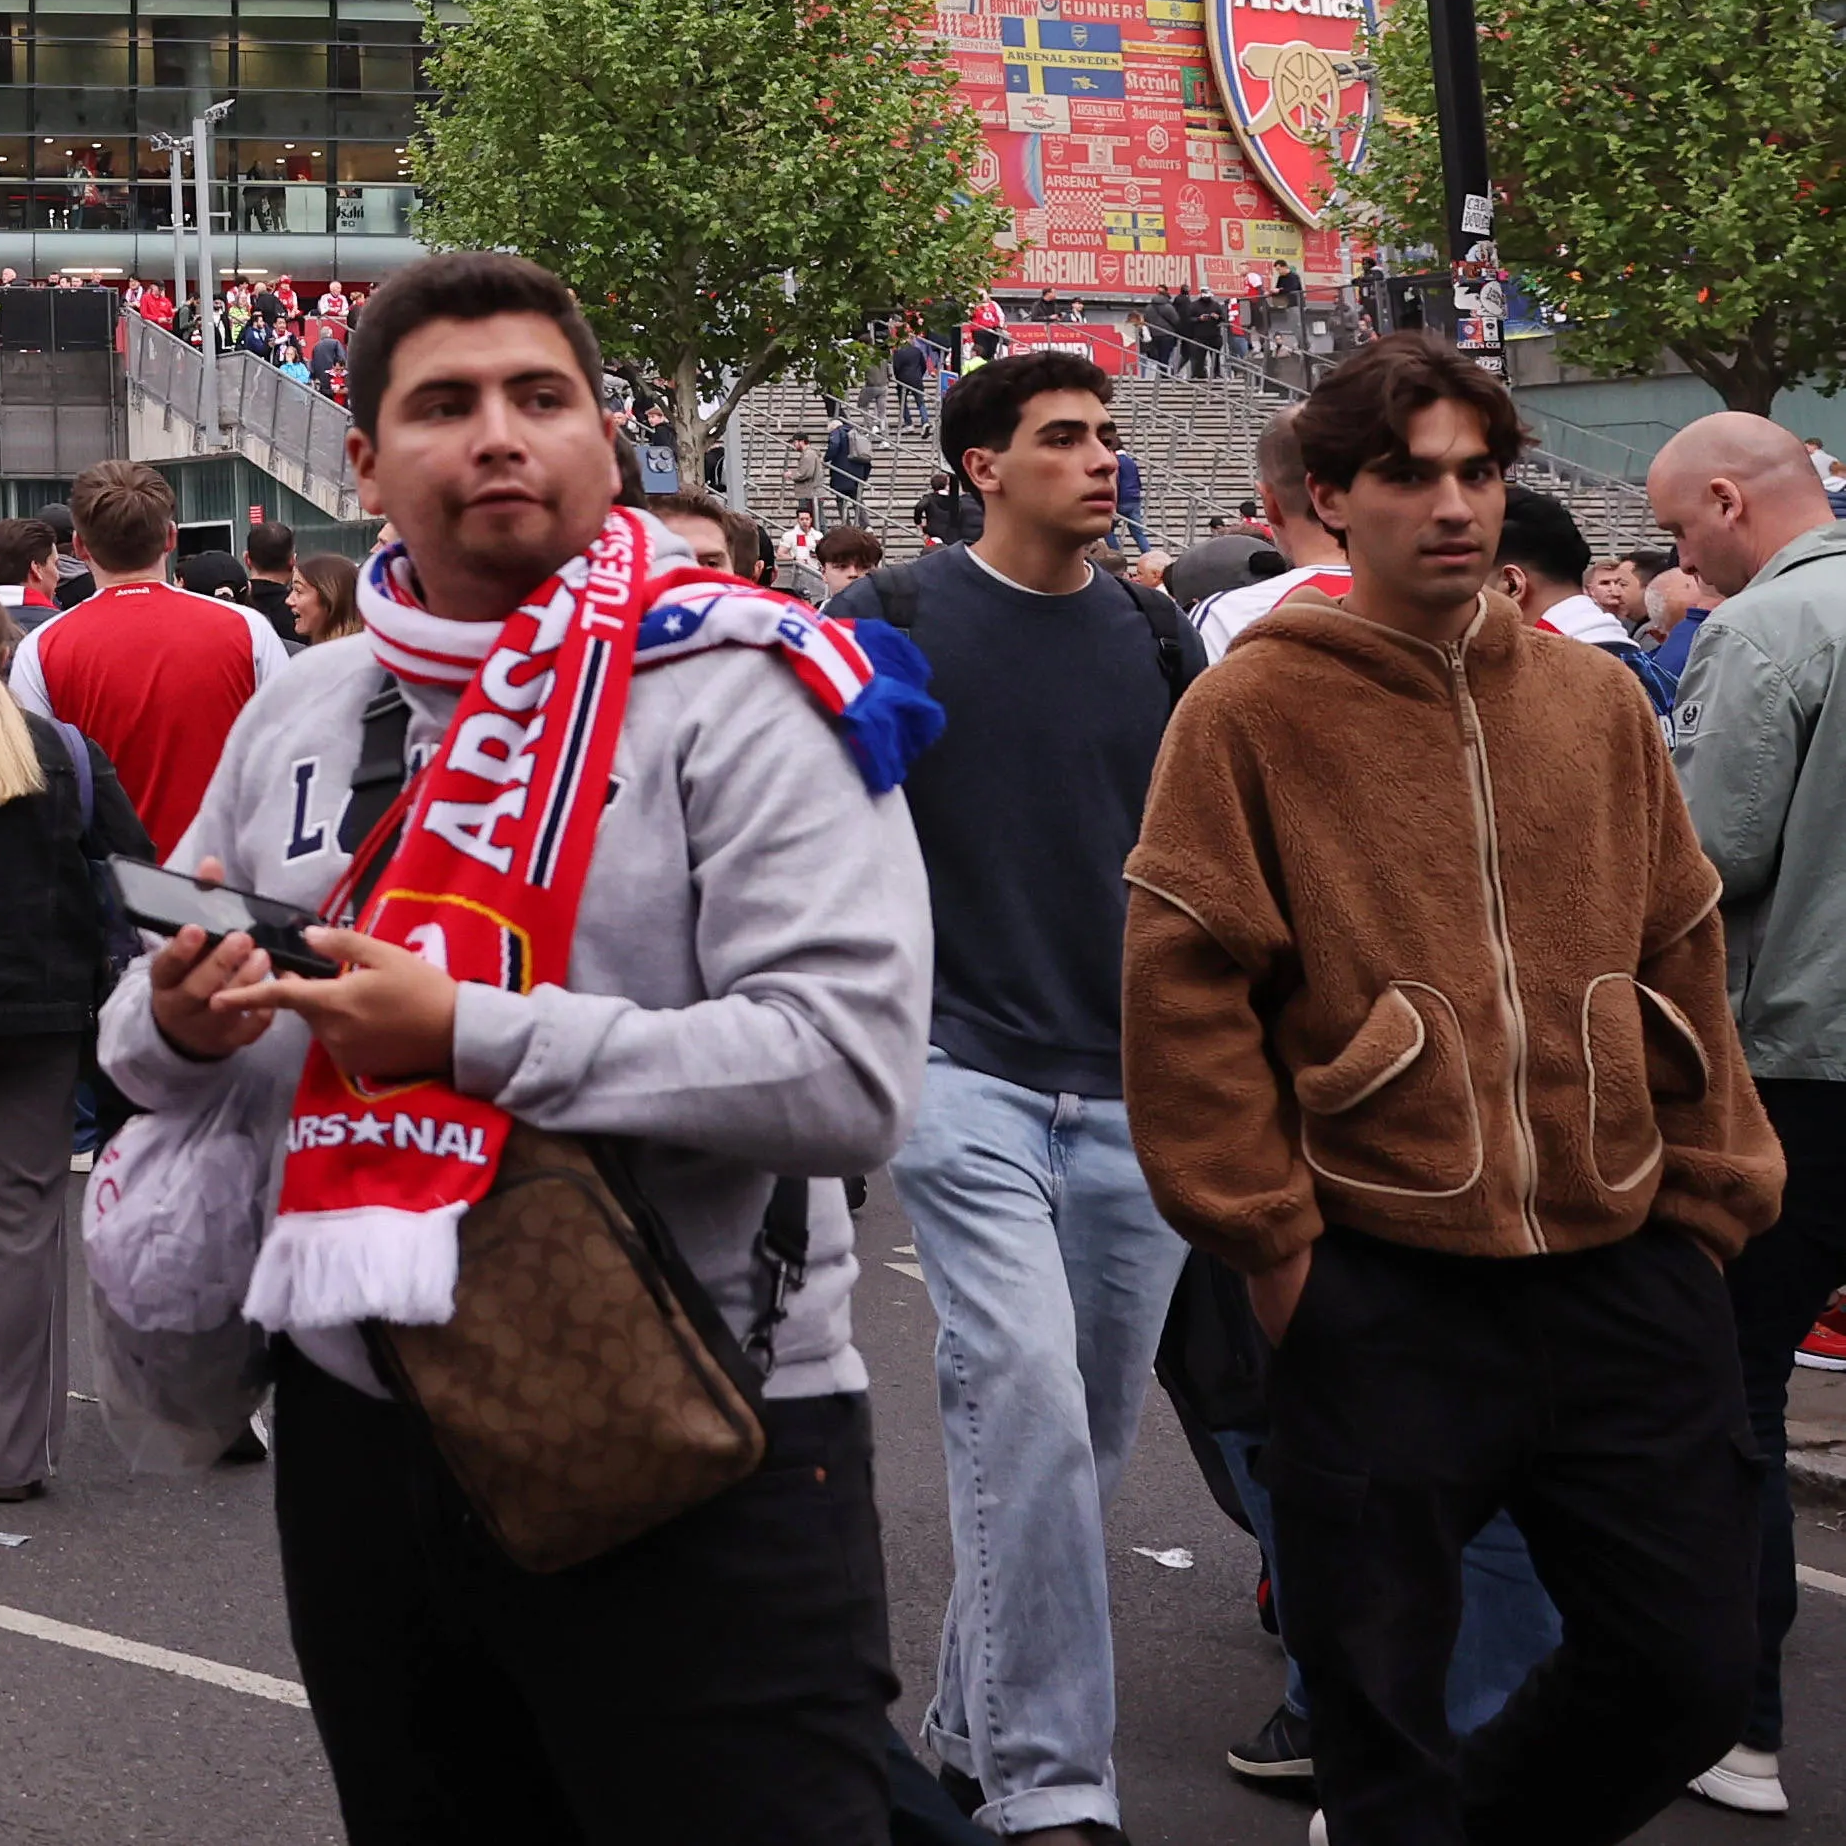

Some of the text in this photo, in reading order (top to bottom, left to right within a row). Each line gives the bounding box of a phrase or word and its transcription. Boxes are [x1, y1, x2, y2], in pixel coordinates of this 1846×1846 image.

[1061, 0, 1145, 19] GUNNERS
[1007, 50, 1120, 67] ARSENAL SWEDEN
[1124, 71, 1181, 93] Kerala
[1045, 175, 1101, 189] ARSENAL
[1052, 233, 1104, 246] CROATIA
[1023, 249, 1100, 285] ARSENAL
[1124, 253, 1191, 288] GEORGIA
